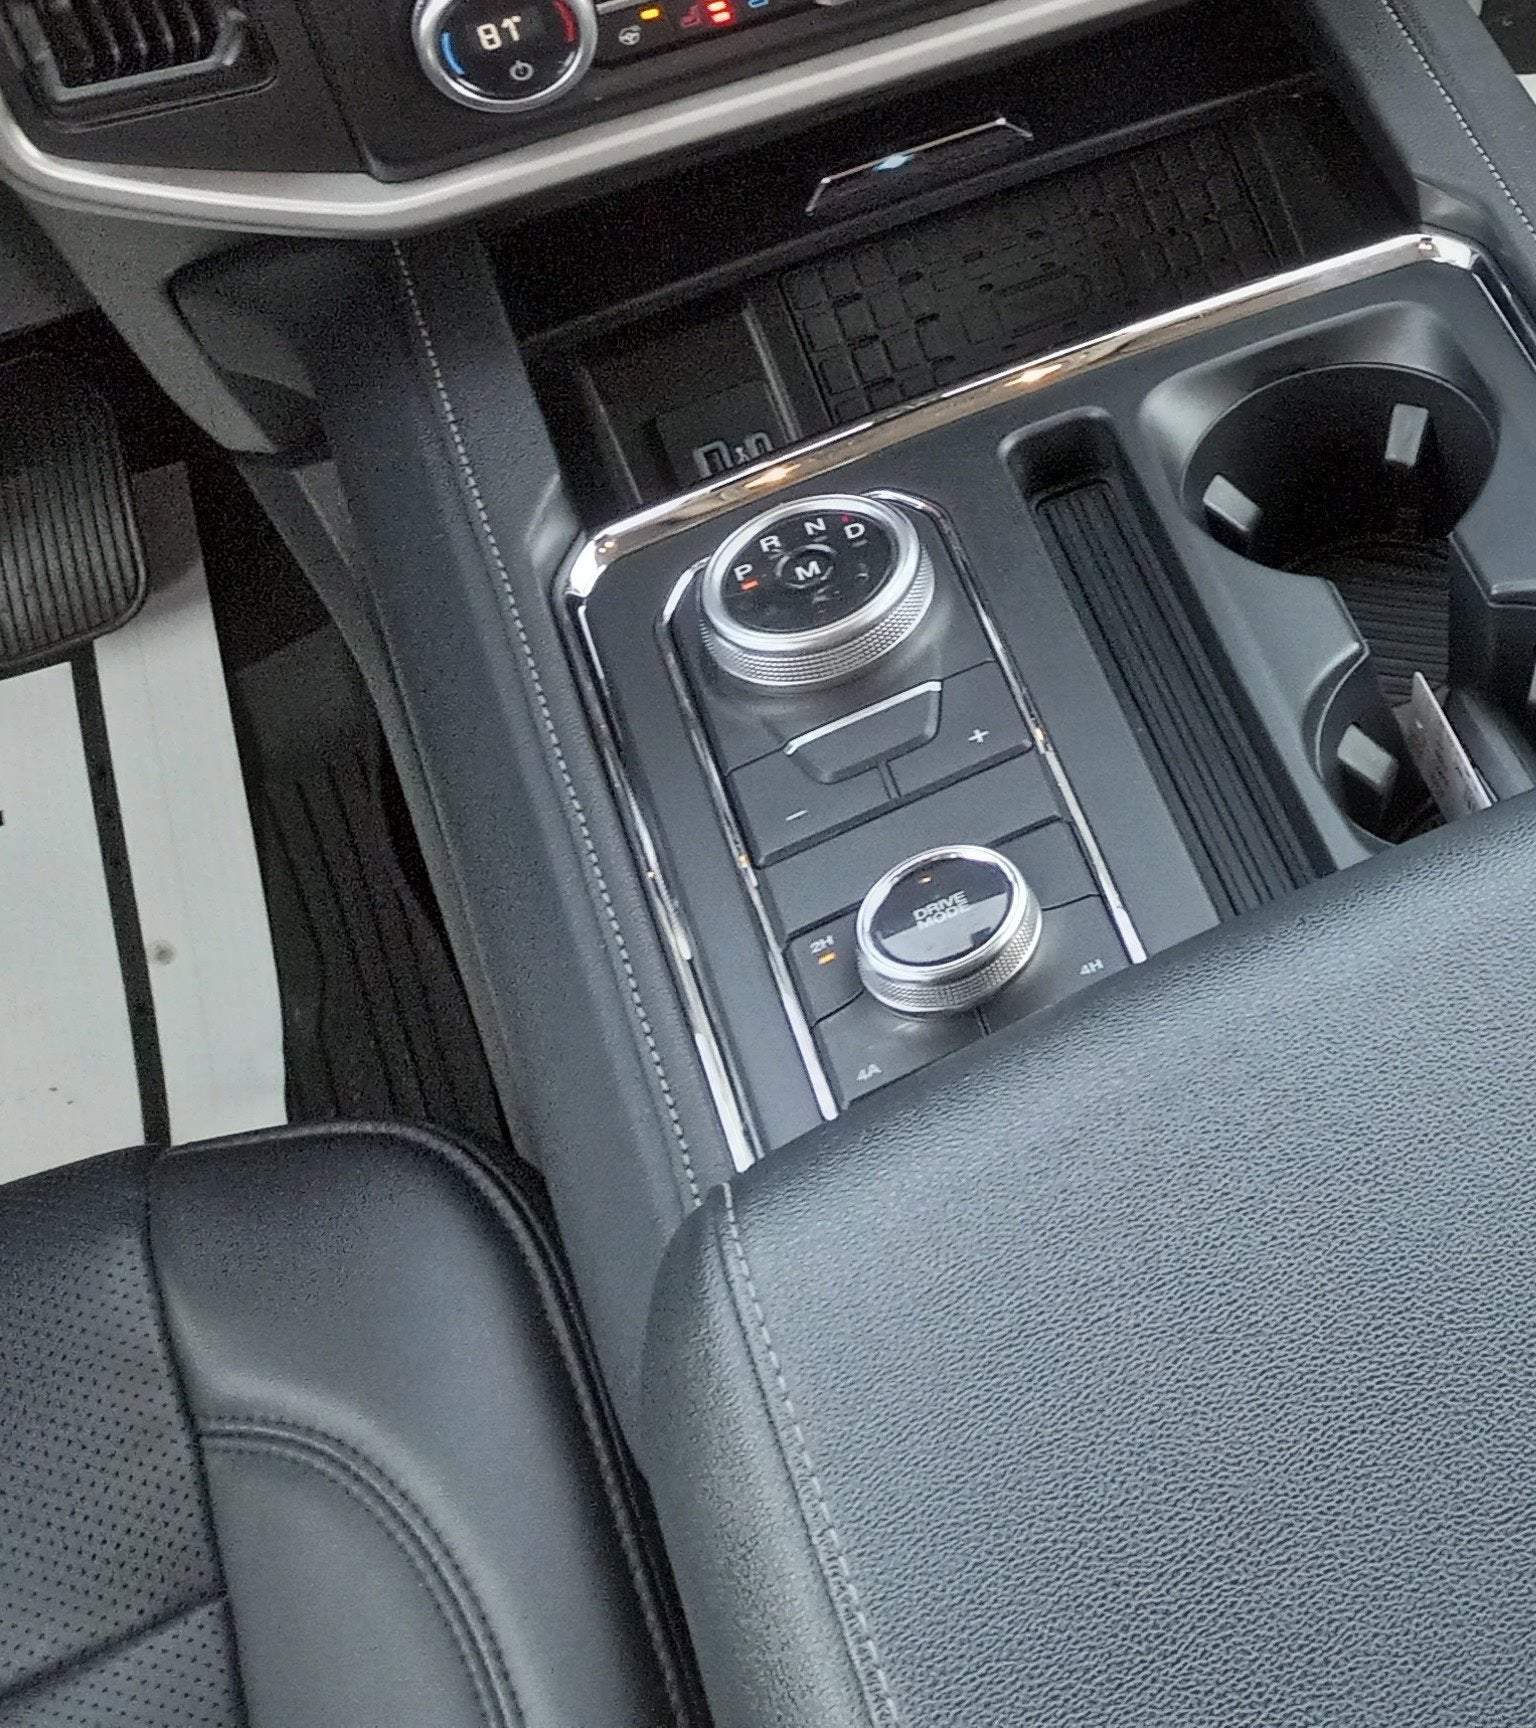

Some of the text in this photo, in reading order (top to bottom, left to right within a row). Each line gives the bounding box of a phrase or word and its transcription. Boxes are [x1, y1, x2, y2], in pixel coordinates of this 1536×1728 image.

[804, 518, 826, 535] N
[844, 523, 865, 539] D
[759, 535, 782, 553] R
[733, 563, 753, 581] P
[794, 561, 821, 580] M
[912, 890, 966, 920] DRIVE
[916, 898, 974, 928] MODE
[809, 935, 835, 954] 2H
[1079, 959, 1104, 976] 4H
[856, 1063, 883, 1082] 4A
